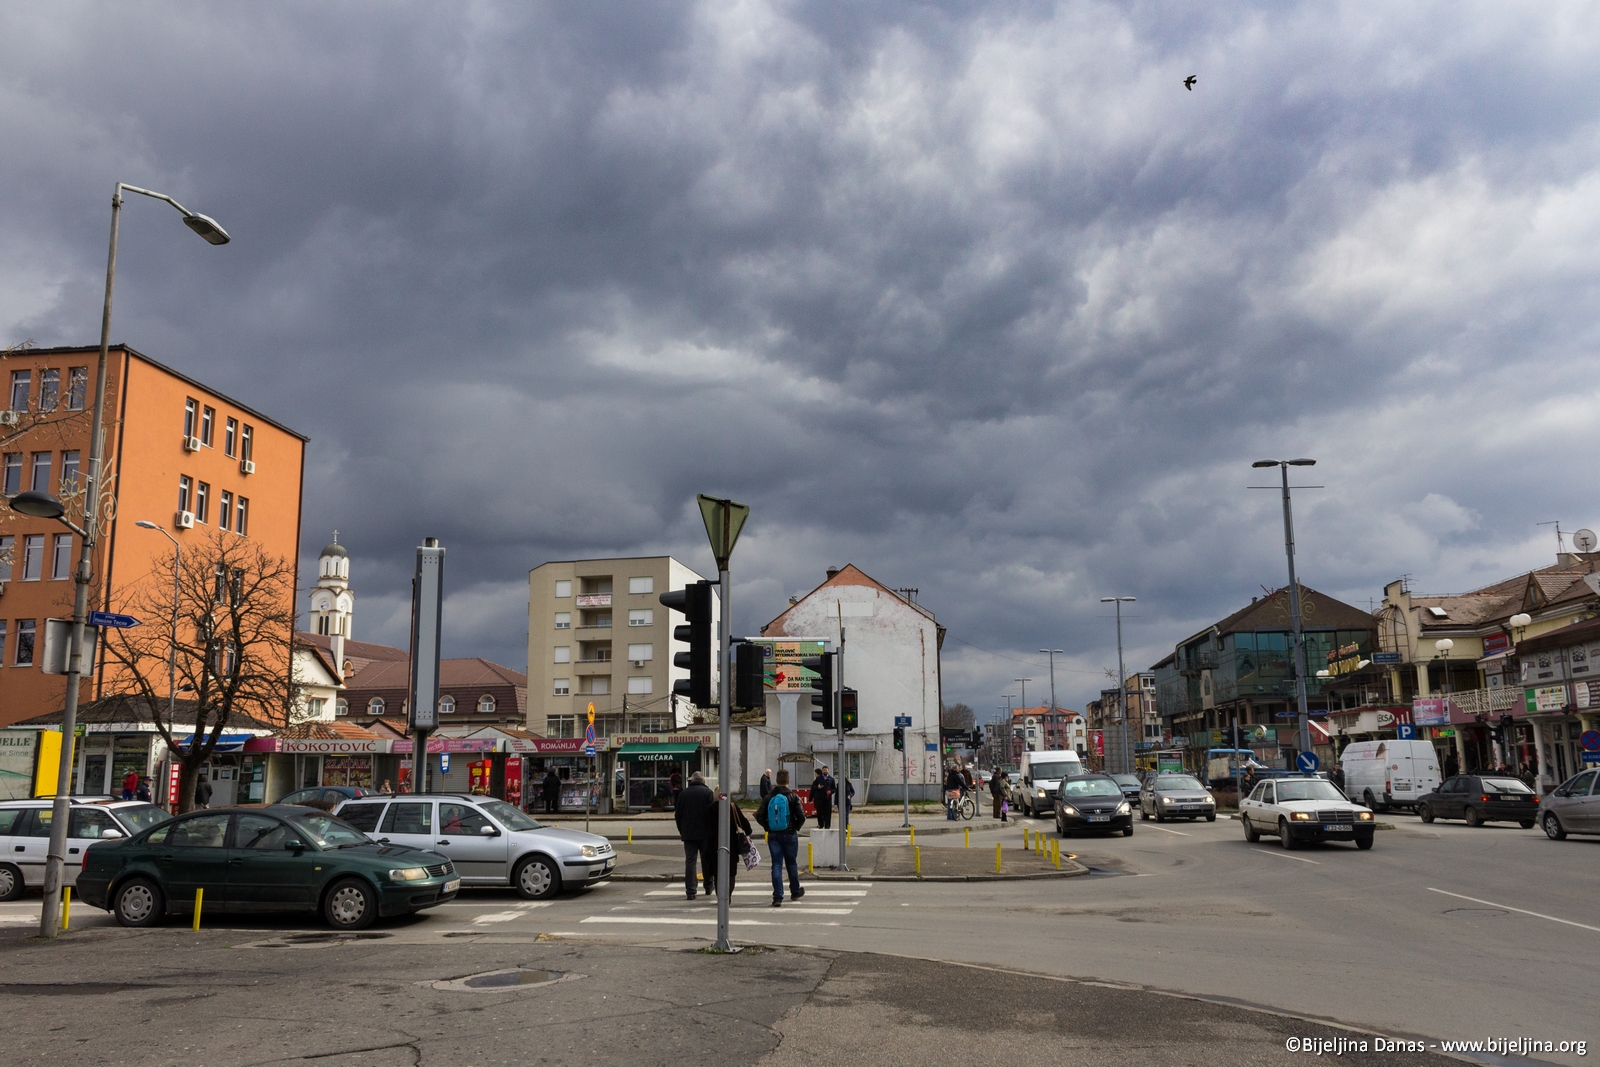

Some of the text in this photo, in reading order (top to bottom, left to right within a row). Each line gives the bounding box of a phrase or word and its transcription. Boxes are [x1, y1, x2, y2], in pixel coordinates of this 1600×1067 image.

[1401, 726, 1412, 739] P
[286, 740, 377, 752] KOKOTOVIĆ
[540, 742, 577, 750] ROMANIJA
[638, 753, 674, 761] CVJEĆARA
[324, 758, 373, 769] ZLATARA
